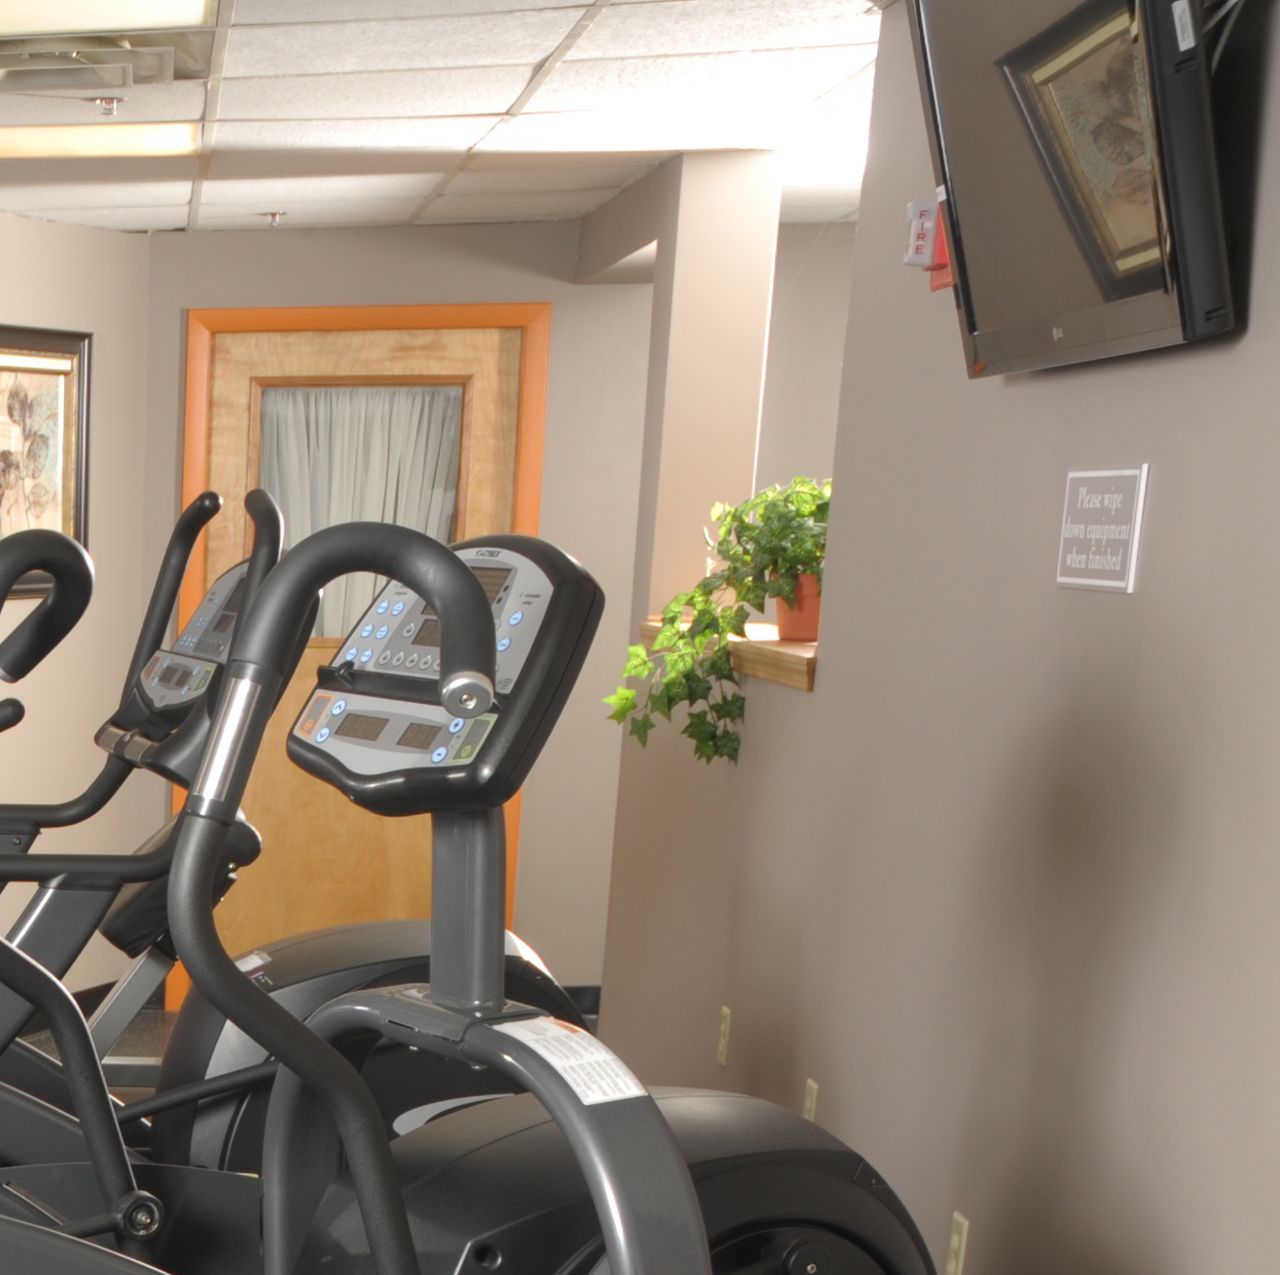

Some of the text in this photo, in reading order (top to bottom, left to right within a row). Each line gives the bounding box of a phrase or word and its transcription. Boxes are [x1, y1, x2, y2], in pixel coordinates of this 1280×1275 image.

[915, 209, 928, 255] FIRE
[1077, 486, 1123, 515] Please wipe
[1063, 515, 1130, 546] down equipment
[1066, 546, 1123, 570] when finished
